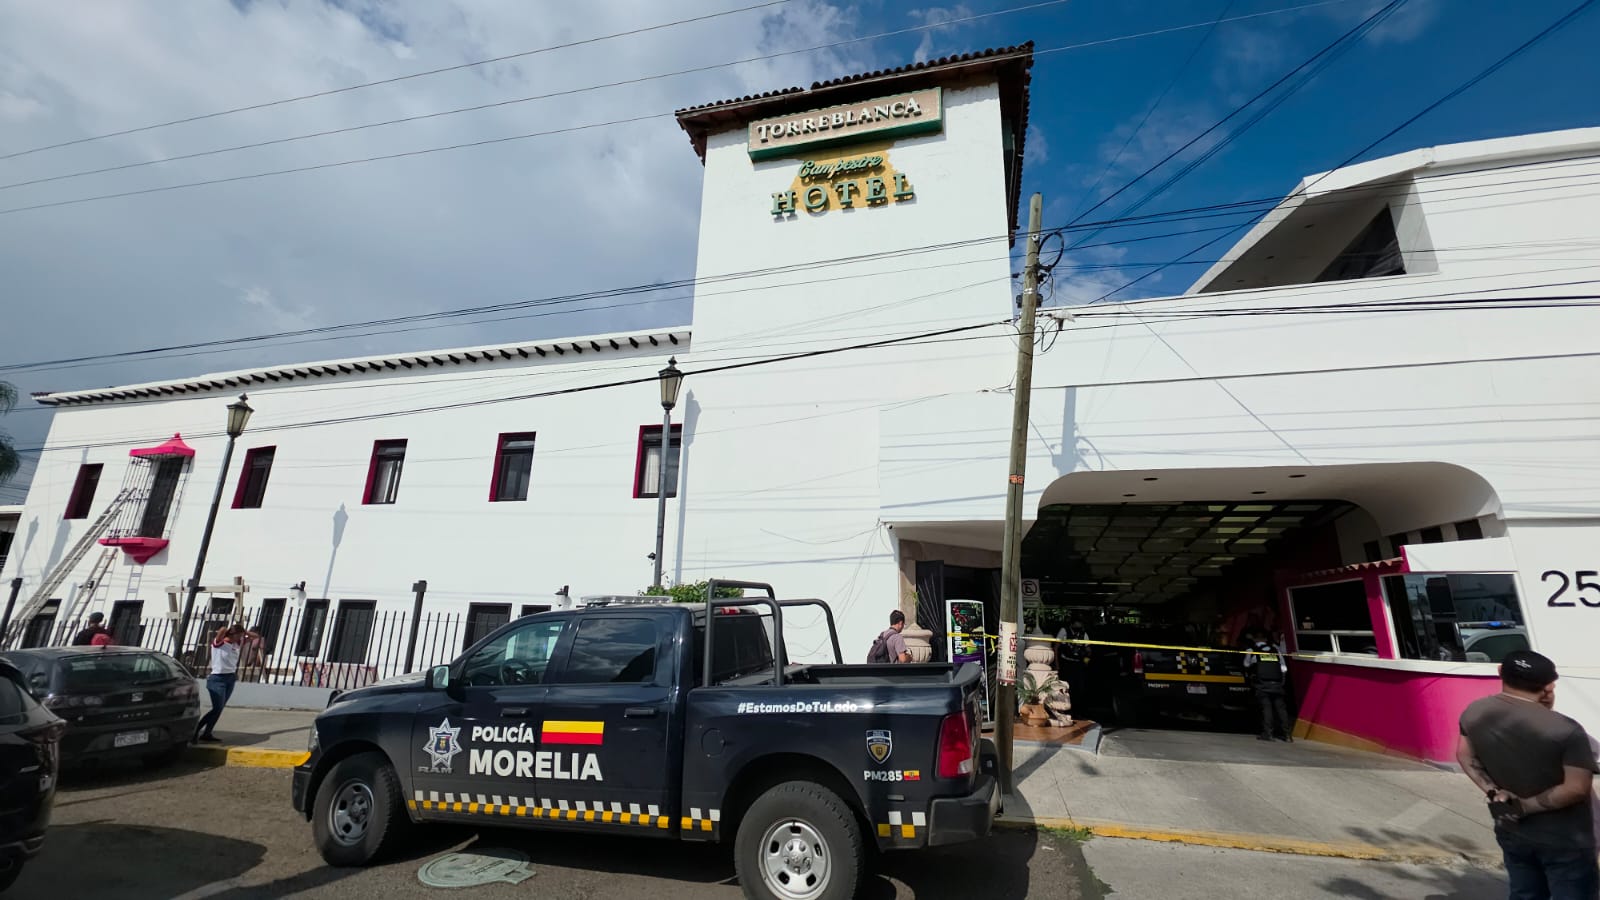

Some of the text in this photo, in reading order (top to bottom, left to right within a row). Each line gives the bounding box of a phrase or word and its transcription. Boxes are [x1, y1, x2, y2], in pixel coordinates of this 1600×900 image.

[757, 97, 922, 142] TORREBLANCA
[799, 155, 883, 178] Campestre
[771, 173, 914, 215] HOTEL
[1541, 570, 1600, 608] 25
[737, 701, 859, 714] #EstamosDeTuLado
[471, 722, 535, 744] POLICÍA
[418, 766, 453, 774] RAM
[469, 749, 603, 781] MORELIA
[863, 770, 903, 782] PM285
